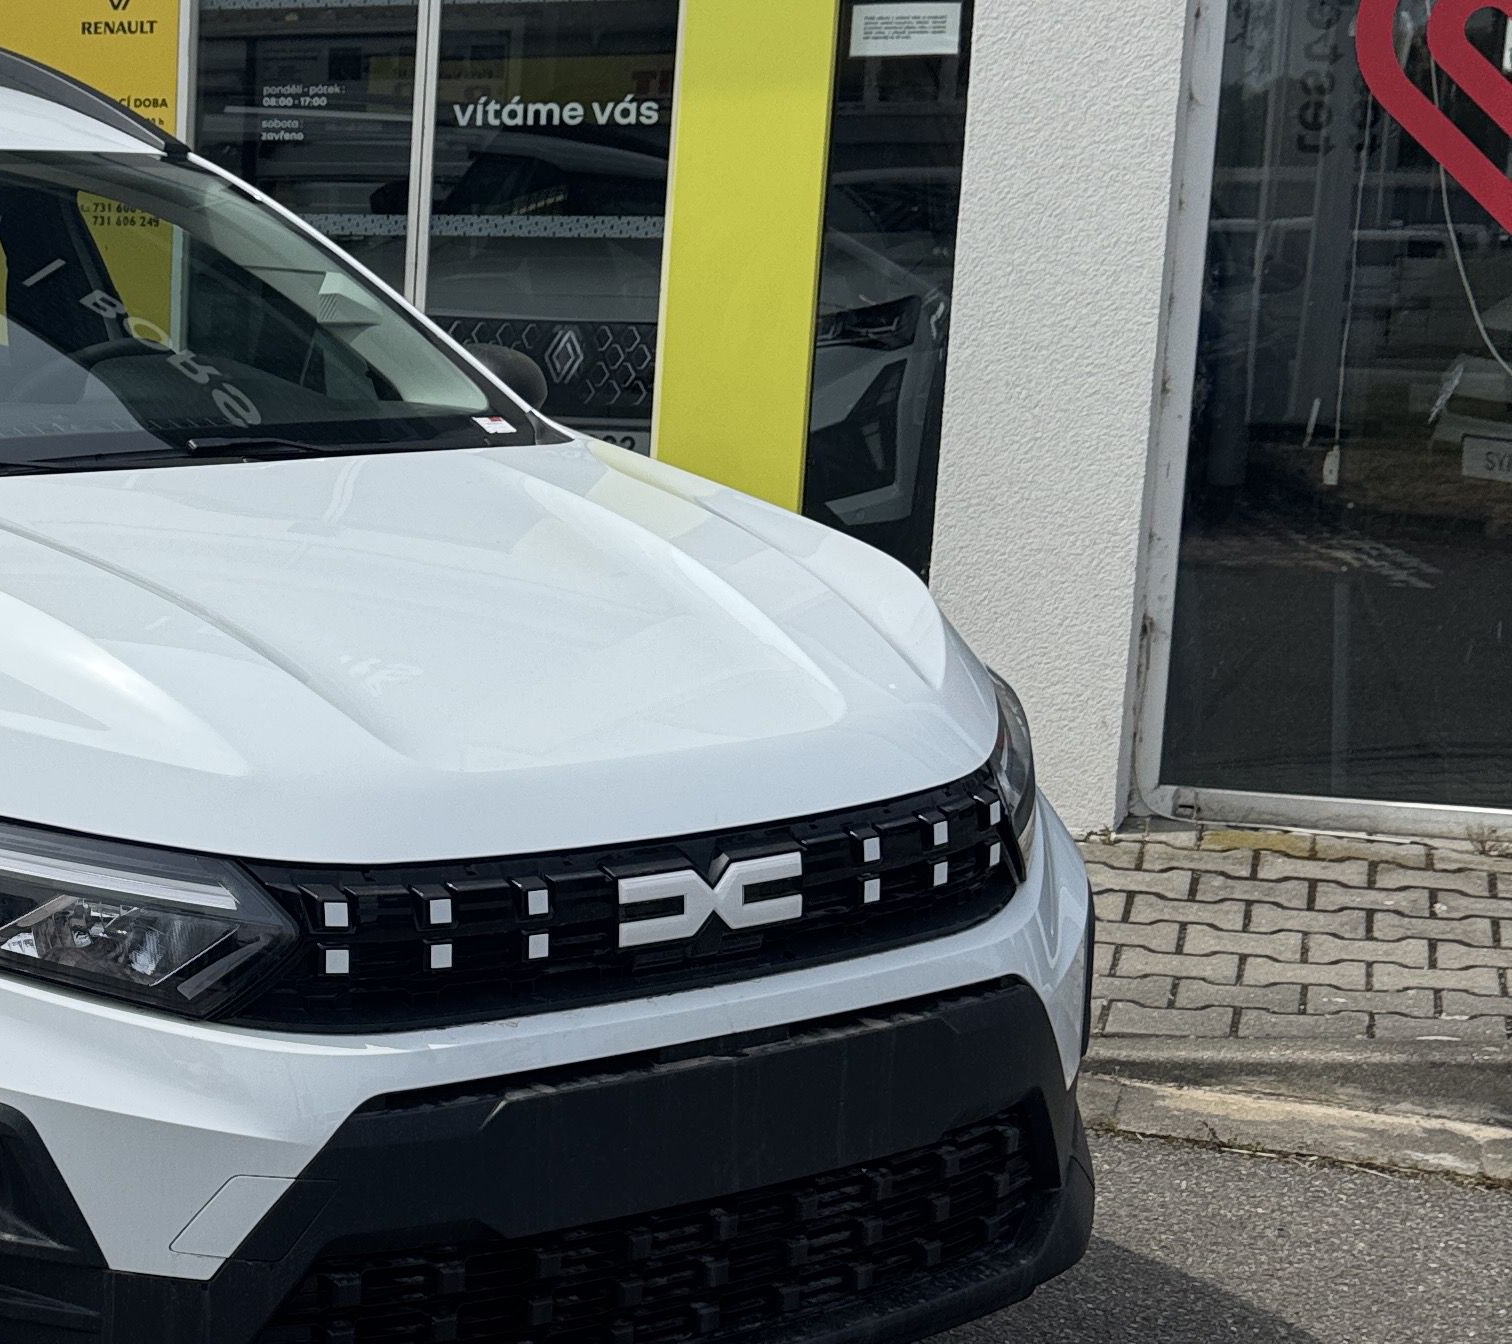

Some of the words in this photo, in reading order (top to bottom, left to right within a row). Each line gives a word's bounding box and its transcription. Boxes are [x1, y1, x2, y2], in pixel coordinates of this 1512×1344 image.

[81, 20, 158, 35] RENAULT
[134, 98, 168, 108] DOBA
[300, 96, 327, 106] 17:00
[453, 95, 585, 127] vítáme
[592, 93, 660, 126] vás
